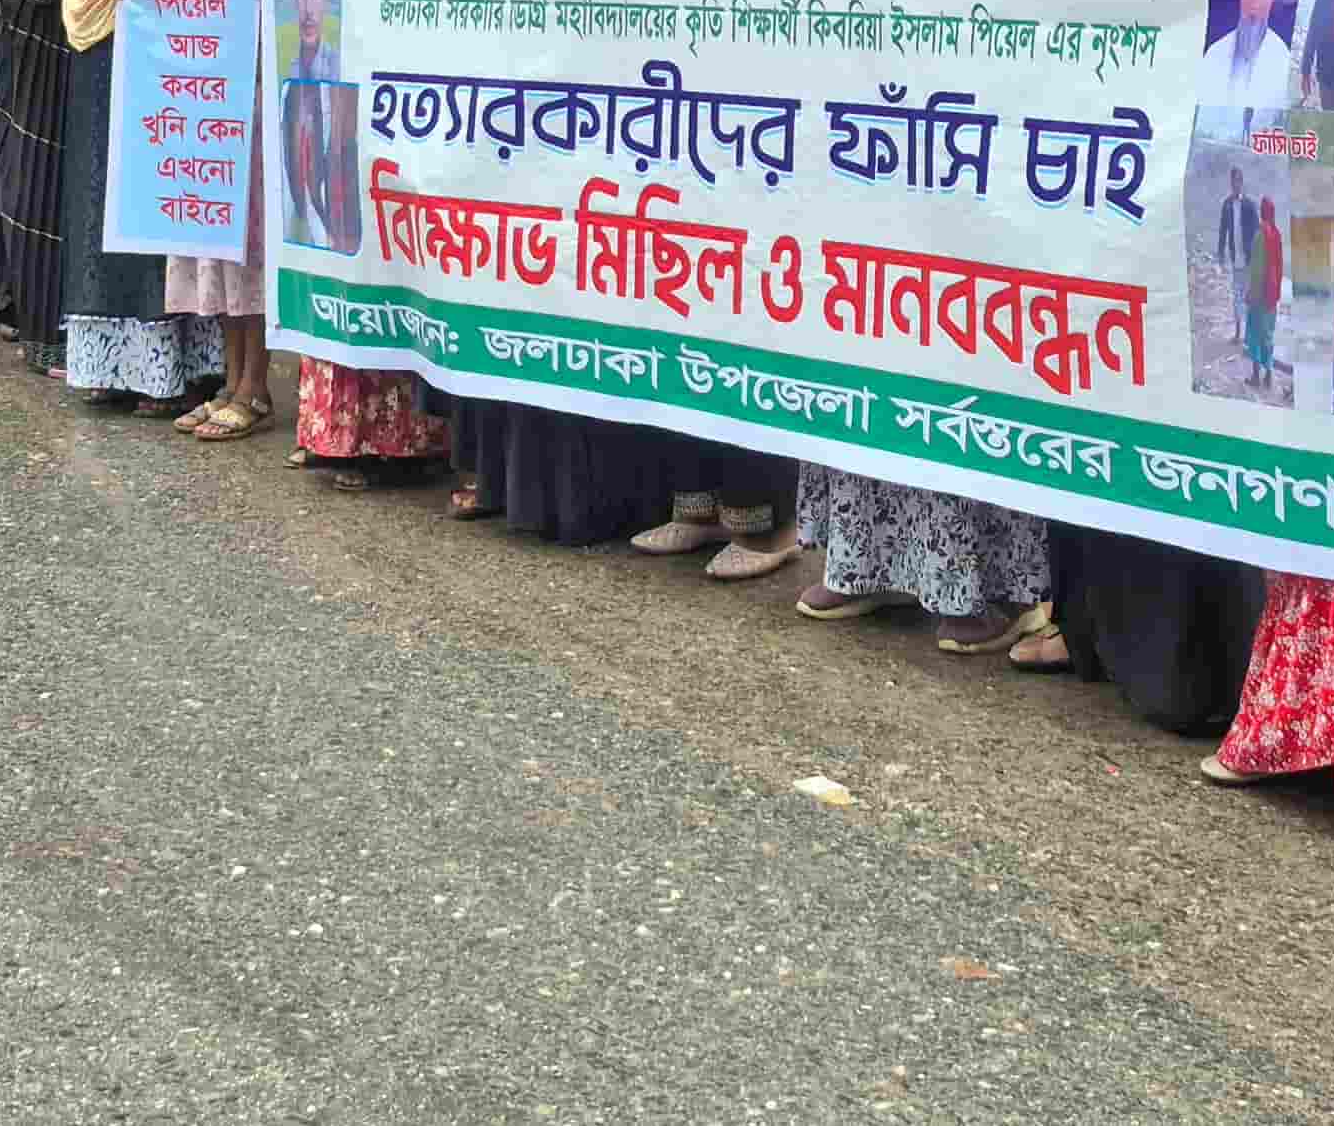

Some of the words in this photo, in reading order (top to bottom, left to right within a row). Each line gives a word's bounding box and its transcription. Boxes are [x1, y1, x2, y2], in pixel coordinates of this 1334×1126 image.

[165, 33, 222, 60] আজ
[889, 2, 962, 60] ইসলাম
[969, 2, 1040, 62] পিয়েল
[1045, 21, 1083, 69] এর
[158, 74, 228, 104] কবরে
[141, 106, 188, 147] খুনি
[369, 58, 802, 189] হত্যারকারীদের
[823, 81, 999, 200] ফাঁসি
[1022, 106, 1156, 228] চাই
[1289, 129, 1318, 161] চাই
[155, 155, 237, 188] এখনো
[154, 189, 236, 226] বাইরে
[574, 176, 750, 320] মিছিল
[760, 234, 805, 324] ও
[820, 239, 1149, 397] মানববন্ধন
[478, 323, 666, 392] জলঢাকা
[675, 340, 879, 436] উপজেলা
[889, 392, 1123, 484] সর্বস্তরের
